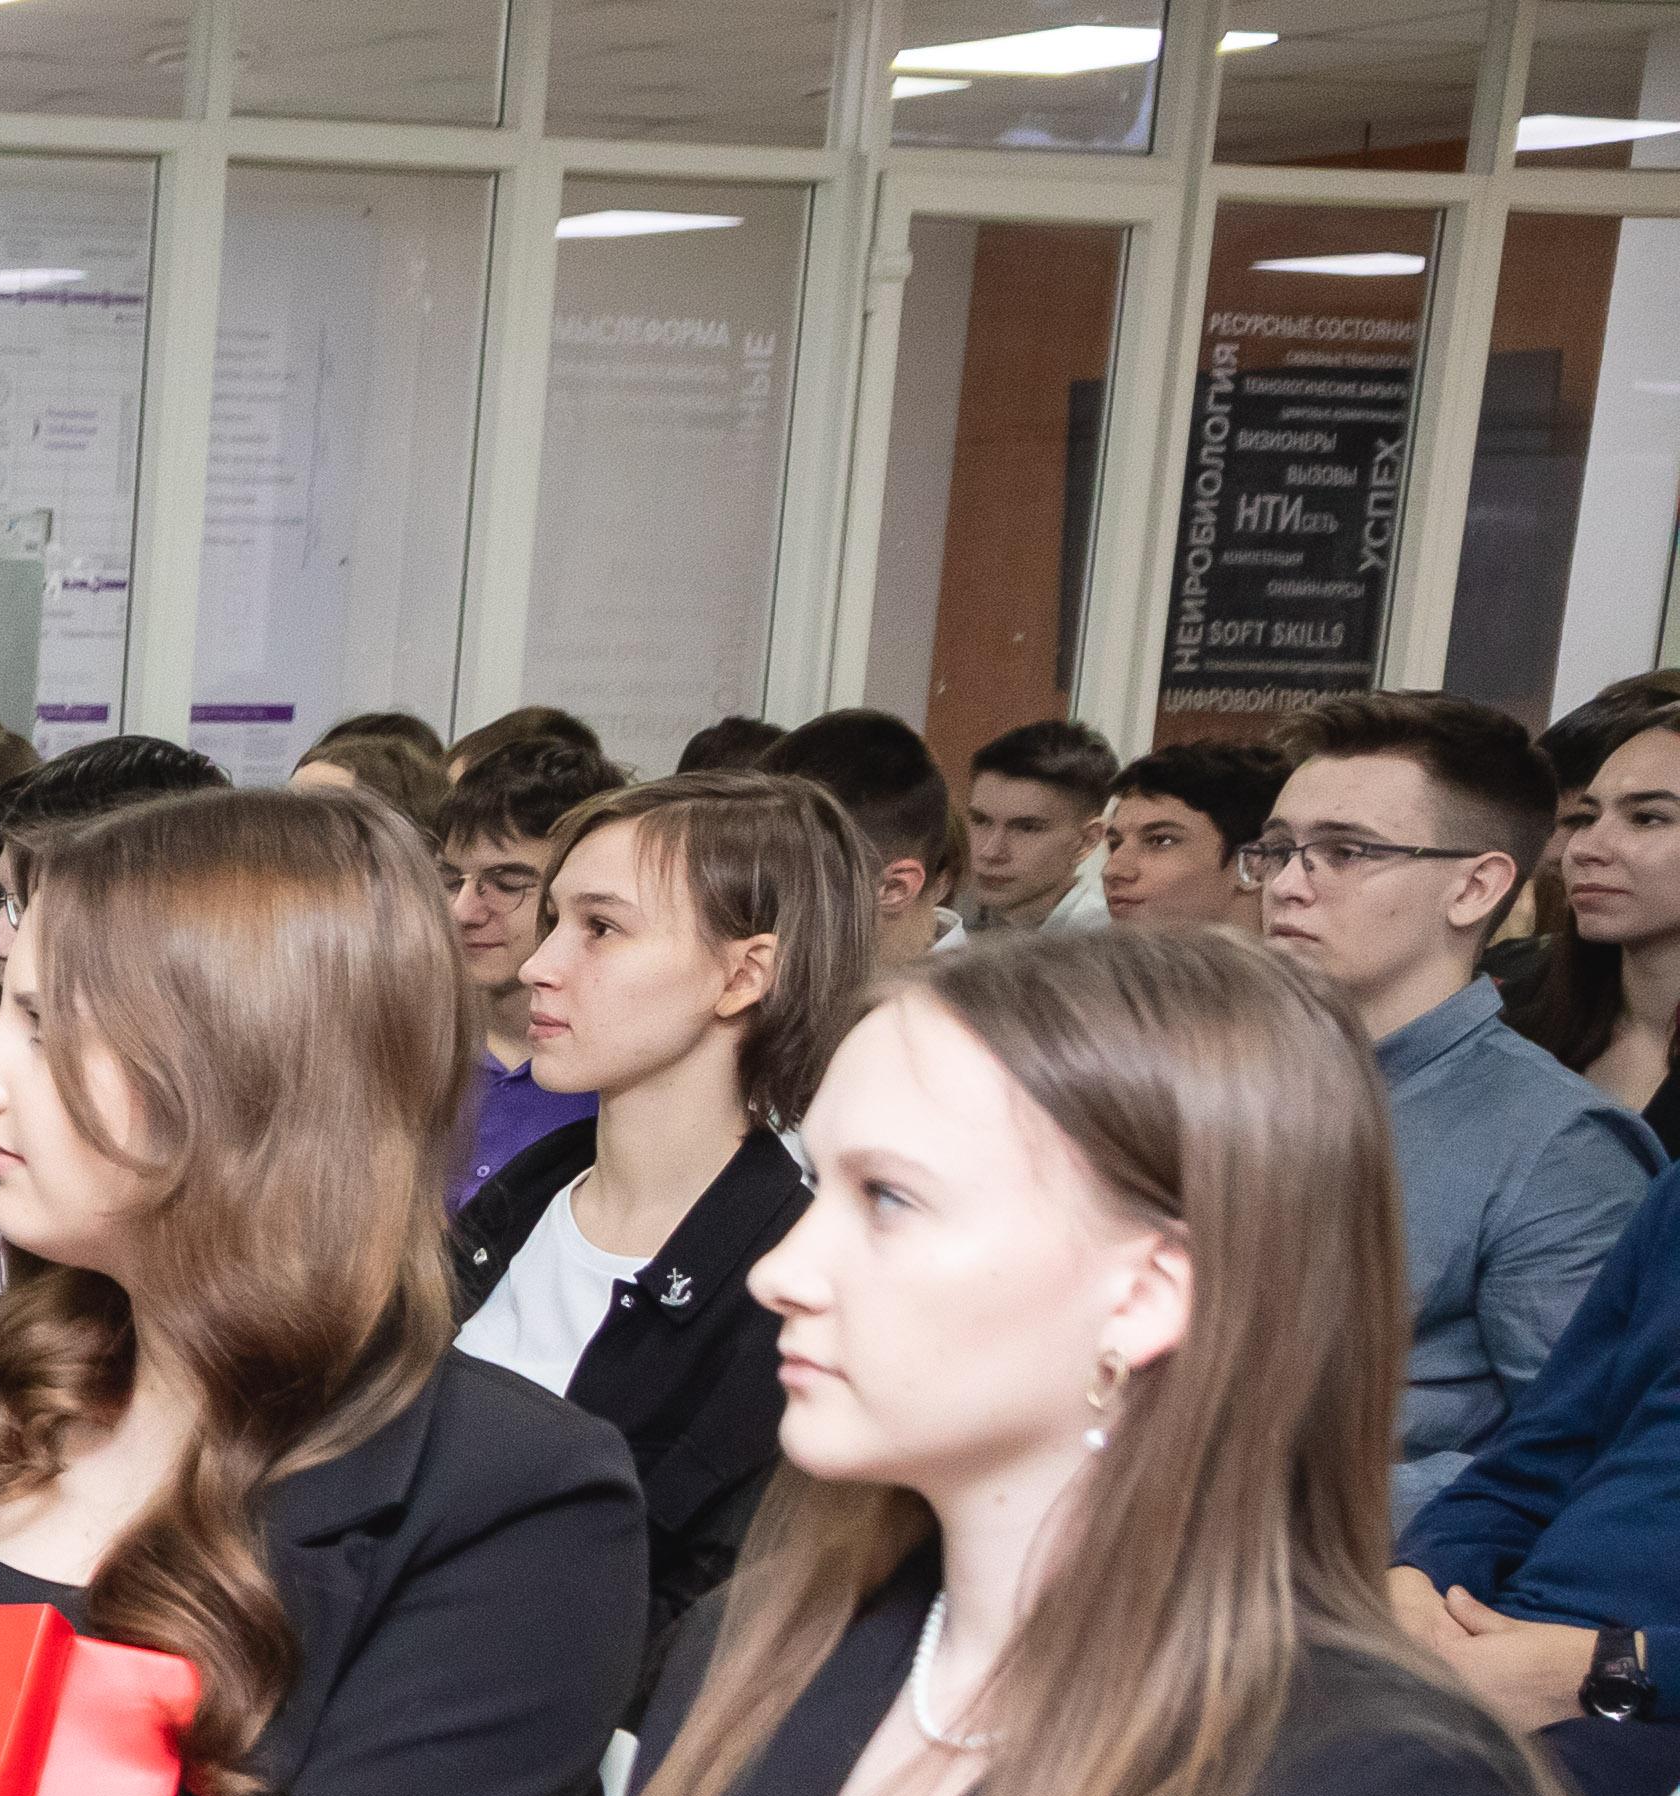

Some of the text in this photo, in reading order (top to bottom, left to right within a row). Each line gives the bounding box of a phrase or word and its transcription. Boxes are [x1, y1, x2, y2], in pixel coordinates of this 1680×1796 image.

[1211, 312, 1312, 338] РЕСУРСНЫЕ
[1236, 428, 1338, 453] ВИЗИОНЕРЫ
[1286, 464, 1358, 486] ВЫЗОВЫ
[1356, 437, 1406, 573] УСПЕХ
[1206, 619, 1346, 648] SOFT SKILLS
[1163, 680, 1276, 714] ЦИФРОВОЙ
